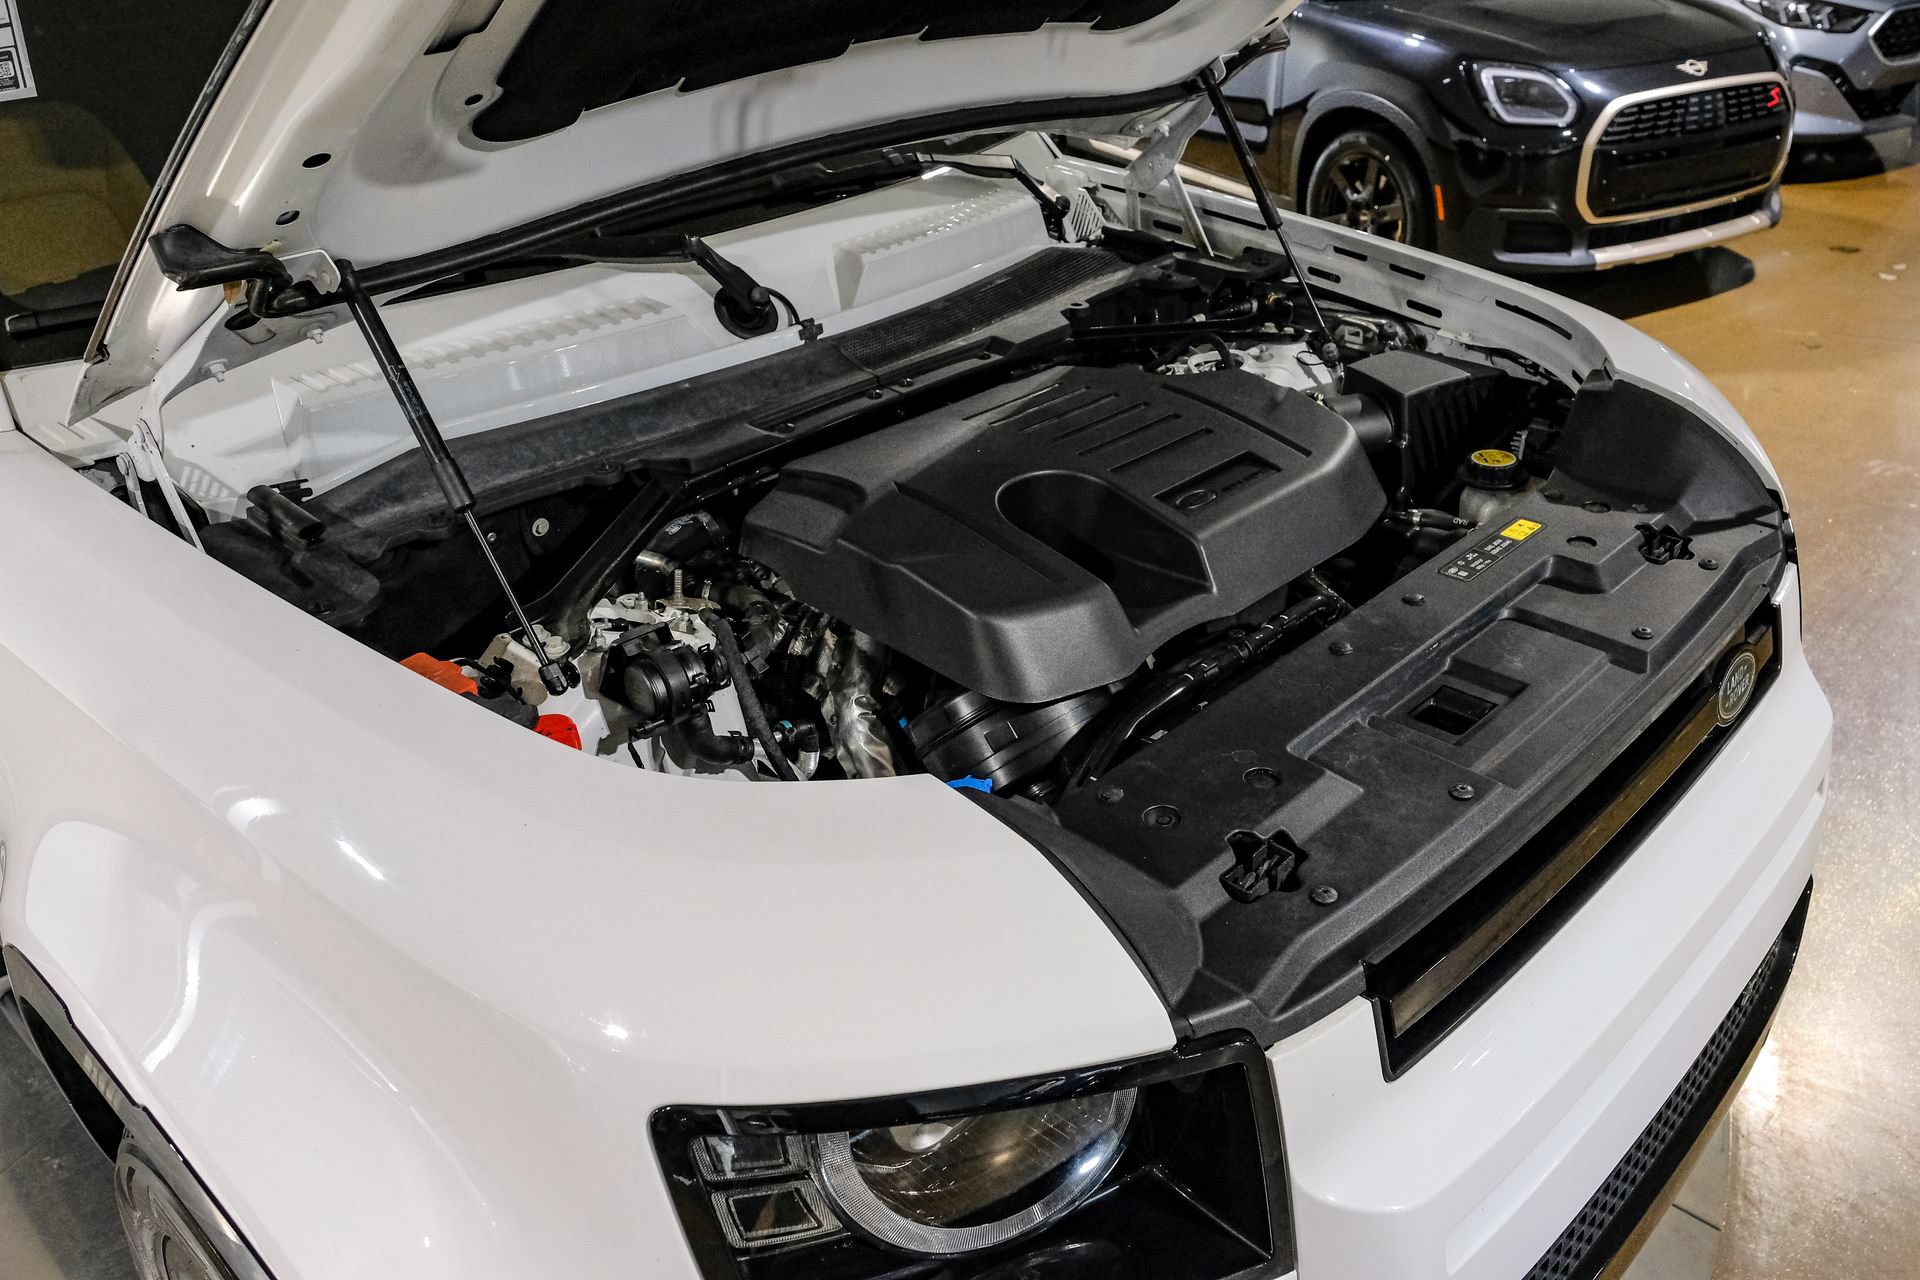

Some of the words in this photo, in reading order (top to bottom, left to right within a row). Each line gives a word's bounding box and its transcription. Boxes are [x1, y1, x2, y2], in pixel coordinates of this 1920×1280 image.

[1767, 87, 1781, 107] S
[1727, 665, 1744, 695] LAND
[1729, 673, 1750, 708] ROVER
